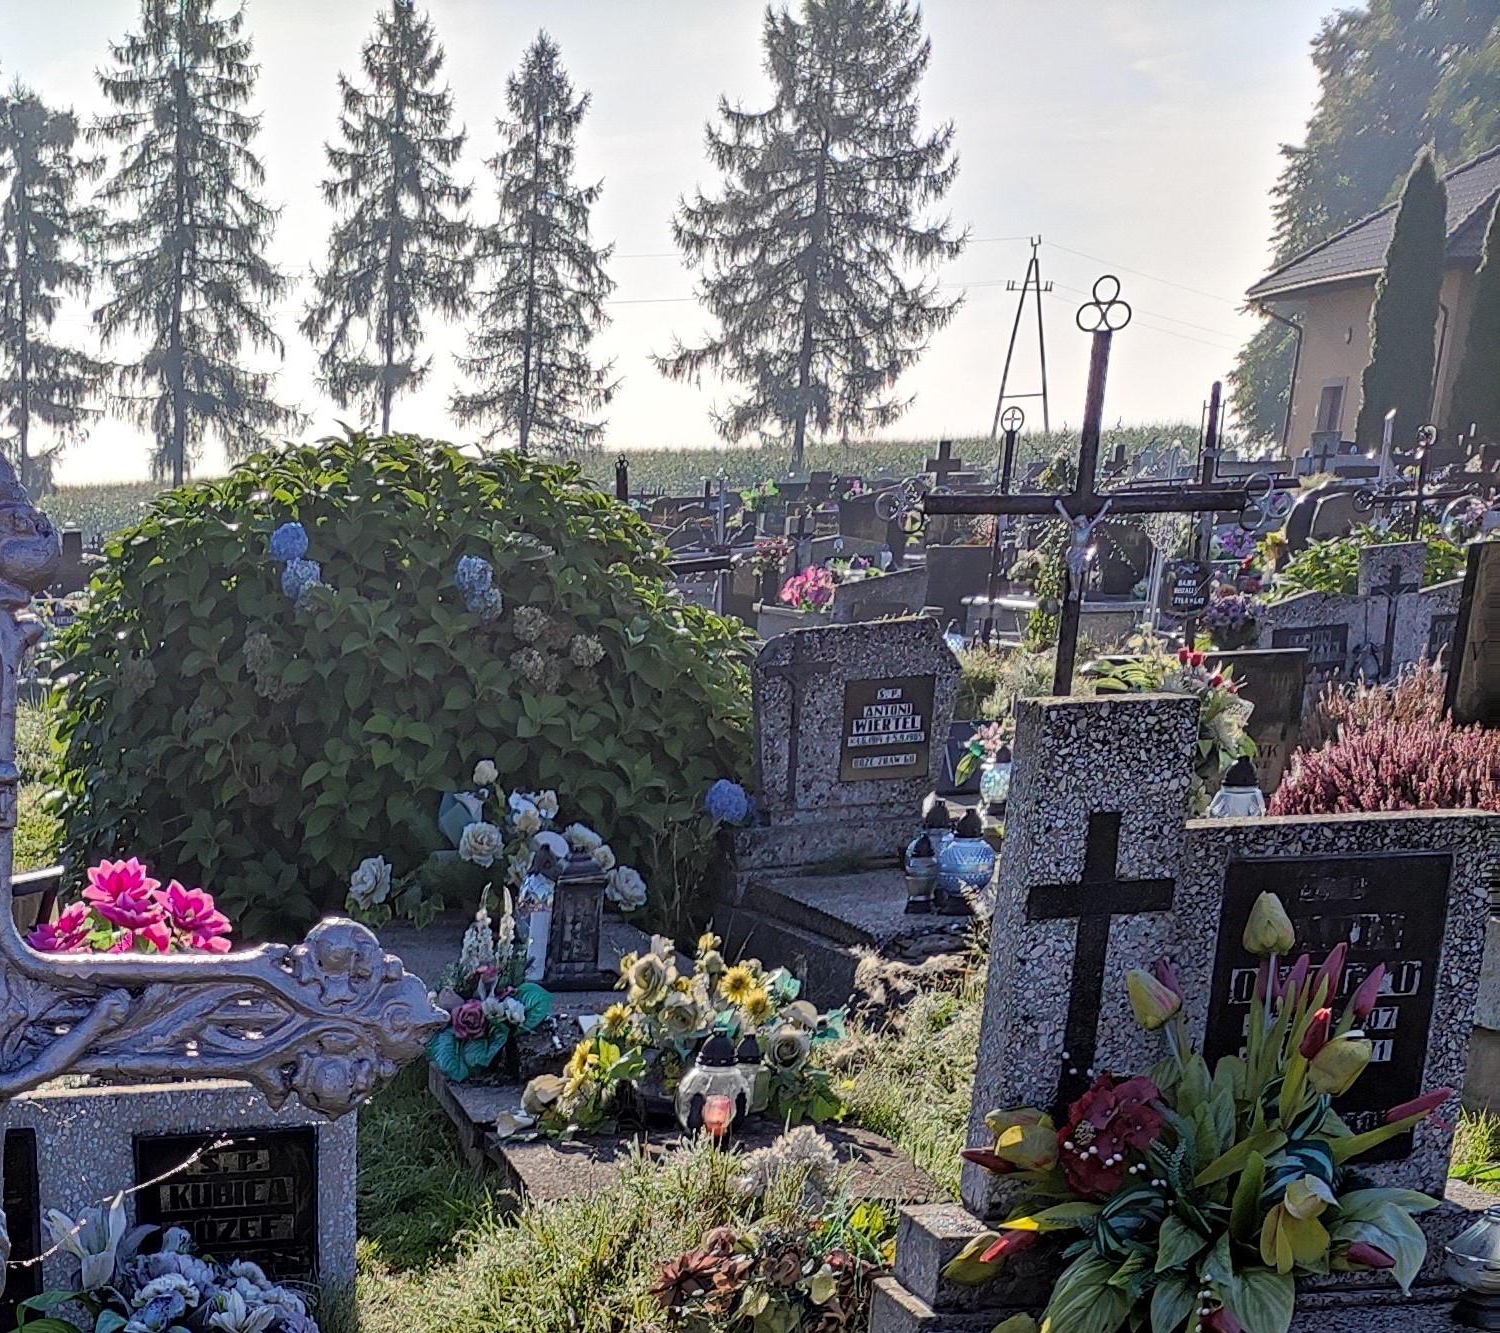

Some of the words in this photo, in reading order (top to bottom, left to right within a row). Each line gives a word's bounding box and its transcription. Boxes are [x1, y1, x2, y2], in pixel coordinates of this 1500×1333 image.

[866, 703, 912, 717] ANTONI
[855, 717, 920, 733] WIERTEL
[169, 1179, 289, 1209] KUBICA
